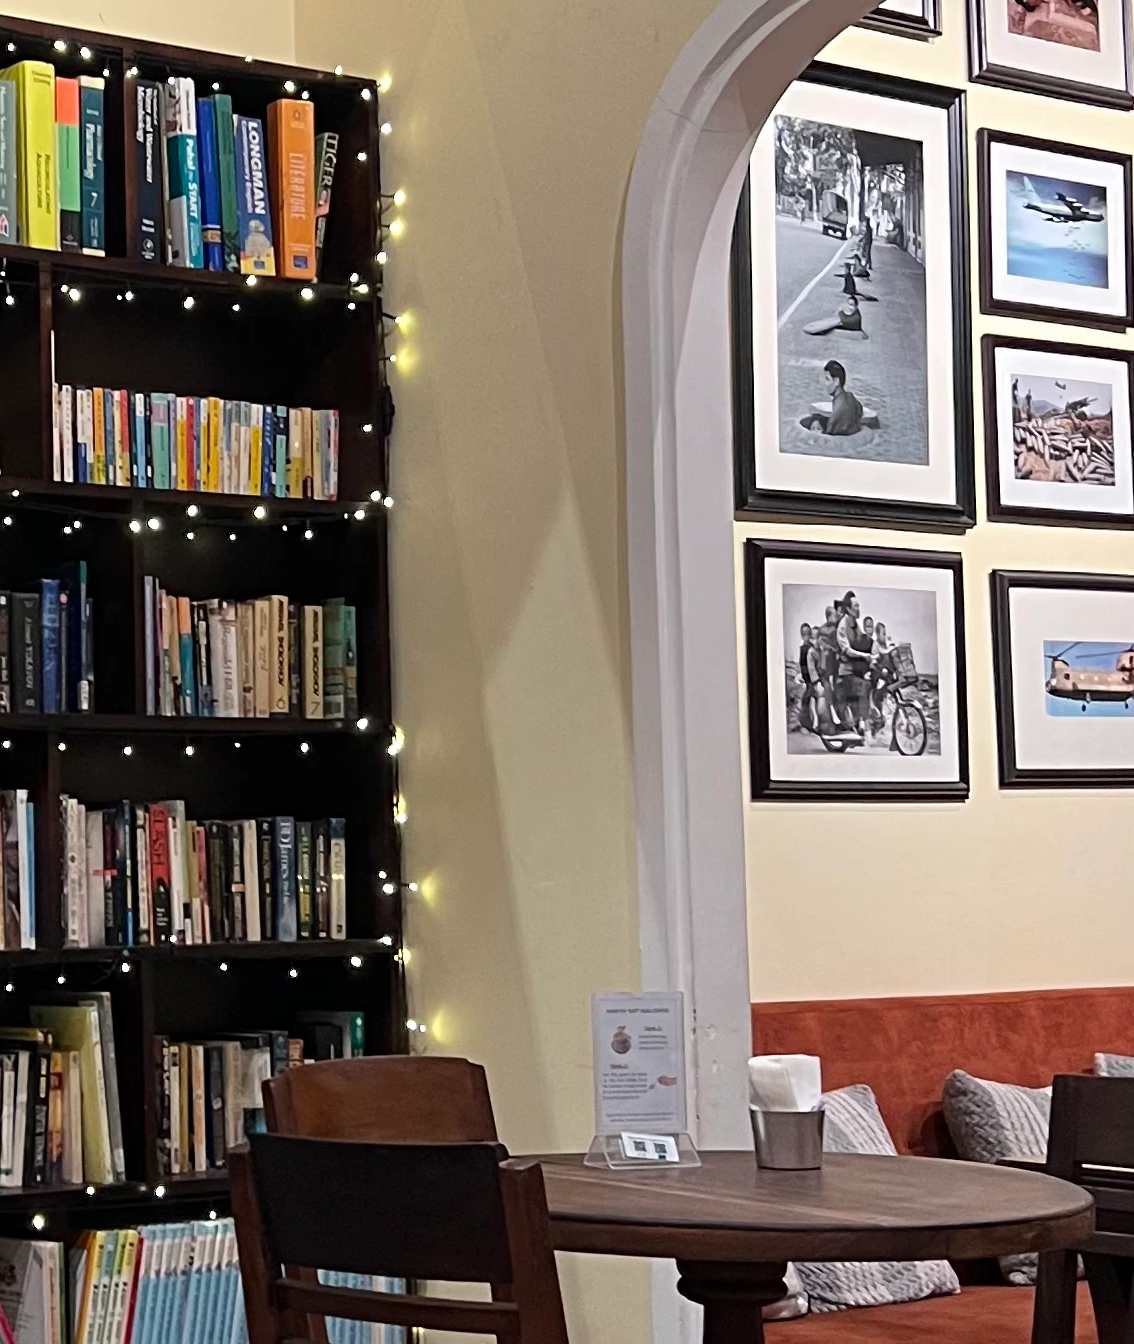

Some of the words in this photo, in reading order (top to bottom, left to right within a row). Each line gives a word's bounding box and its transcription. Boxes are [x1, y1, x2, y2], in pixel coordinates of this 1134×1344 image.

[145, 114, 153, 132] and
[248, 121, 266, 214] LONGMAN
[289, 152, 306, 220] LITERATURE
[321, 138, 338, 186] TIGER
[311, 701, 321, 715] 7
[152, 809, 165, 865] SLASH
